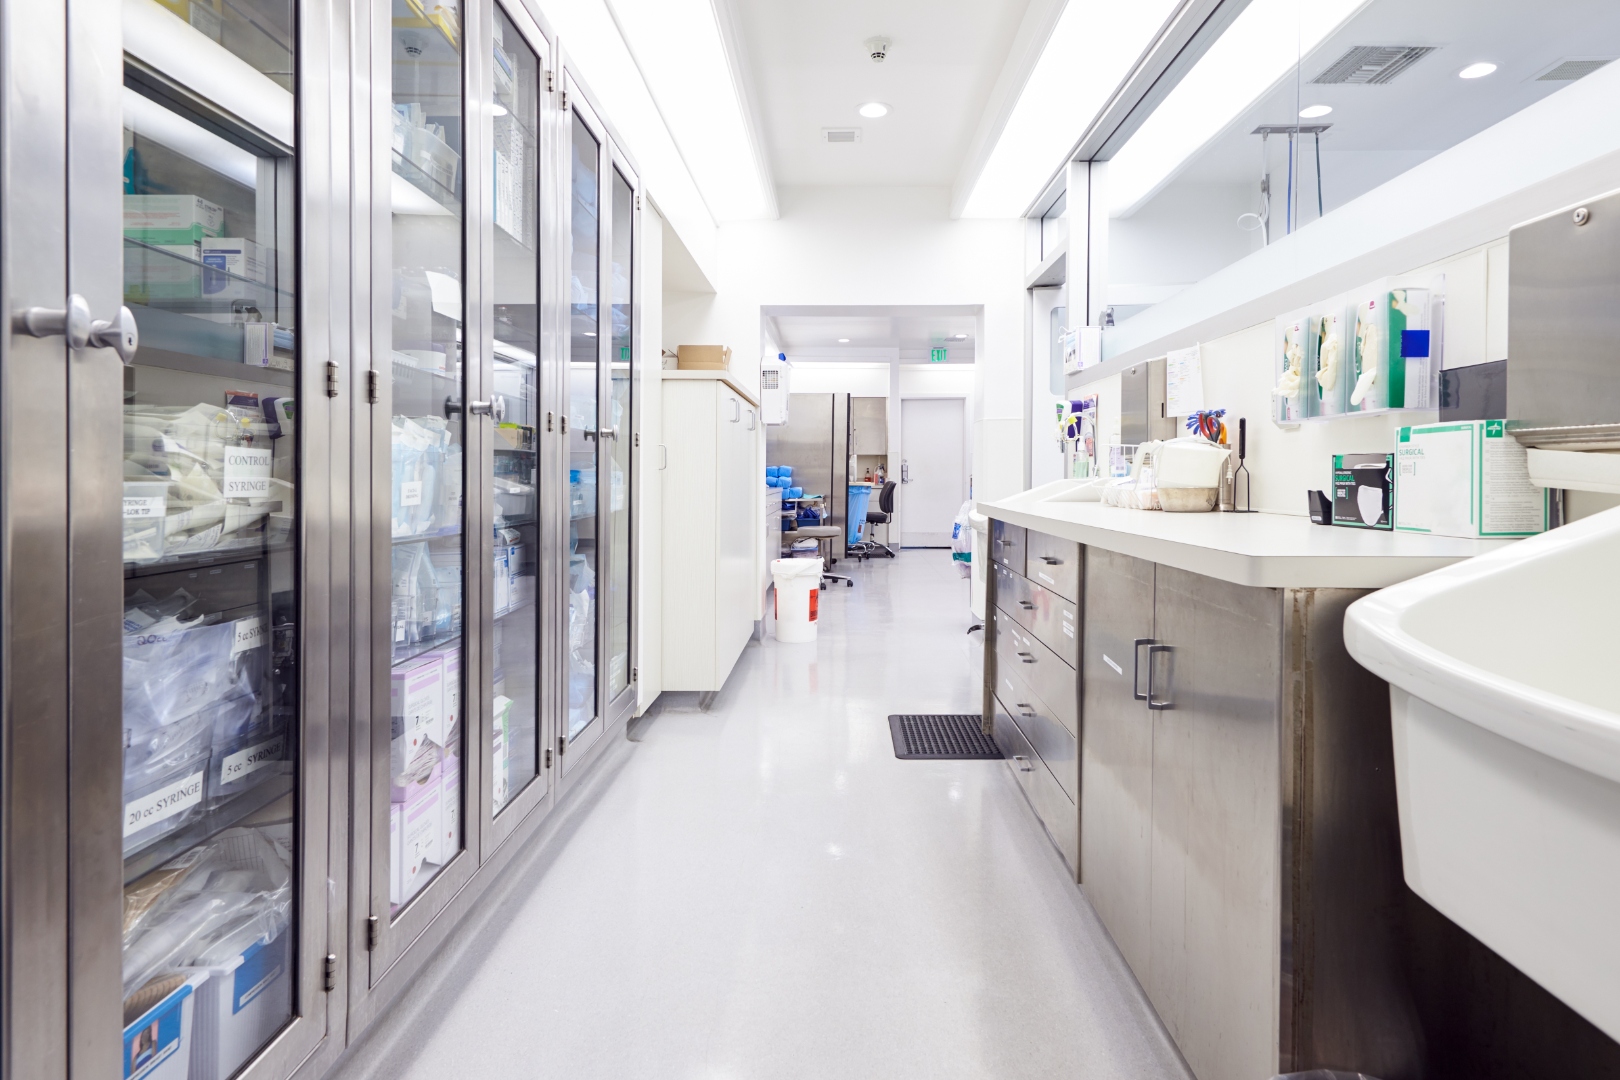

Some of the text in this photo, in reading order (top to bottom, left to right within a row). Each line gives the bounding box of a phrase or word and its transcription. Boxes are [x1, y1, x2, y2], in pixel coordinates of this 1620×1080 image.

[931, 349, 948, 362] EXIT
[228, 455, 269, 466] CONTROL
[229, 481, 266, 491] SYRINGE
[123, 499, 148, 507] YRINGE
[237, 631, 242, 643] 5
[415, 715, 420, 726] 7
[227, 741, 281, 776] 5 cc SYRINGE
[129, 781, 201, 826] 20 cc SYRINGE
[414, 842, 420, 853] 7
